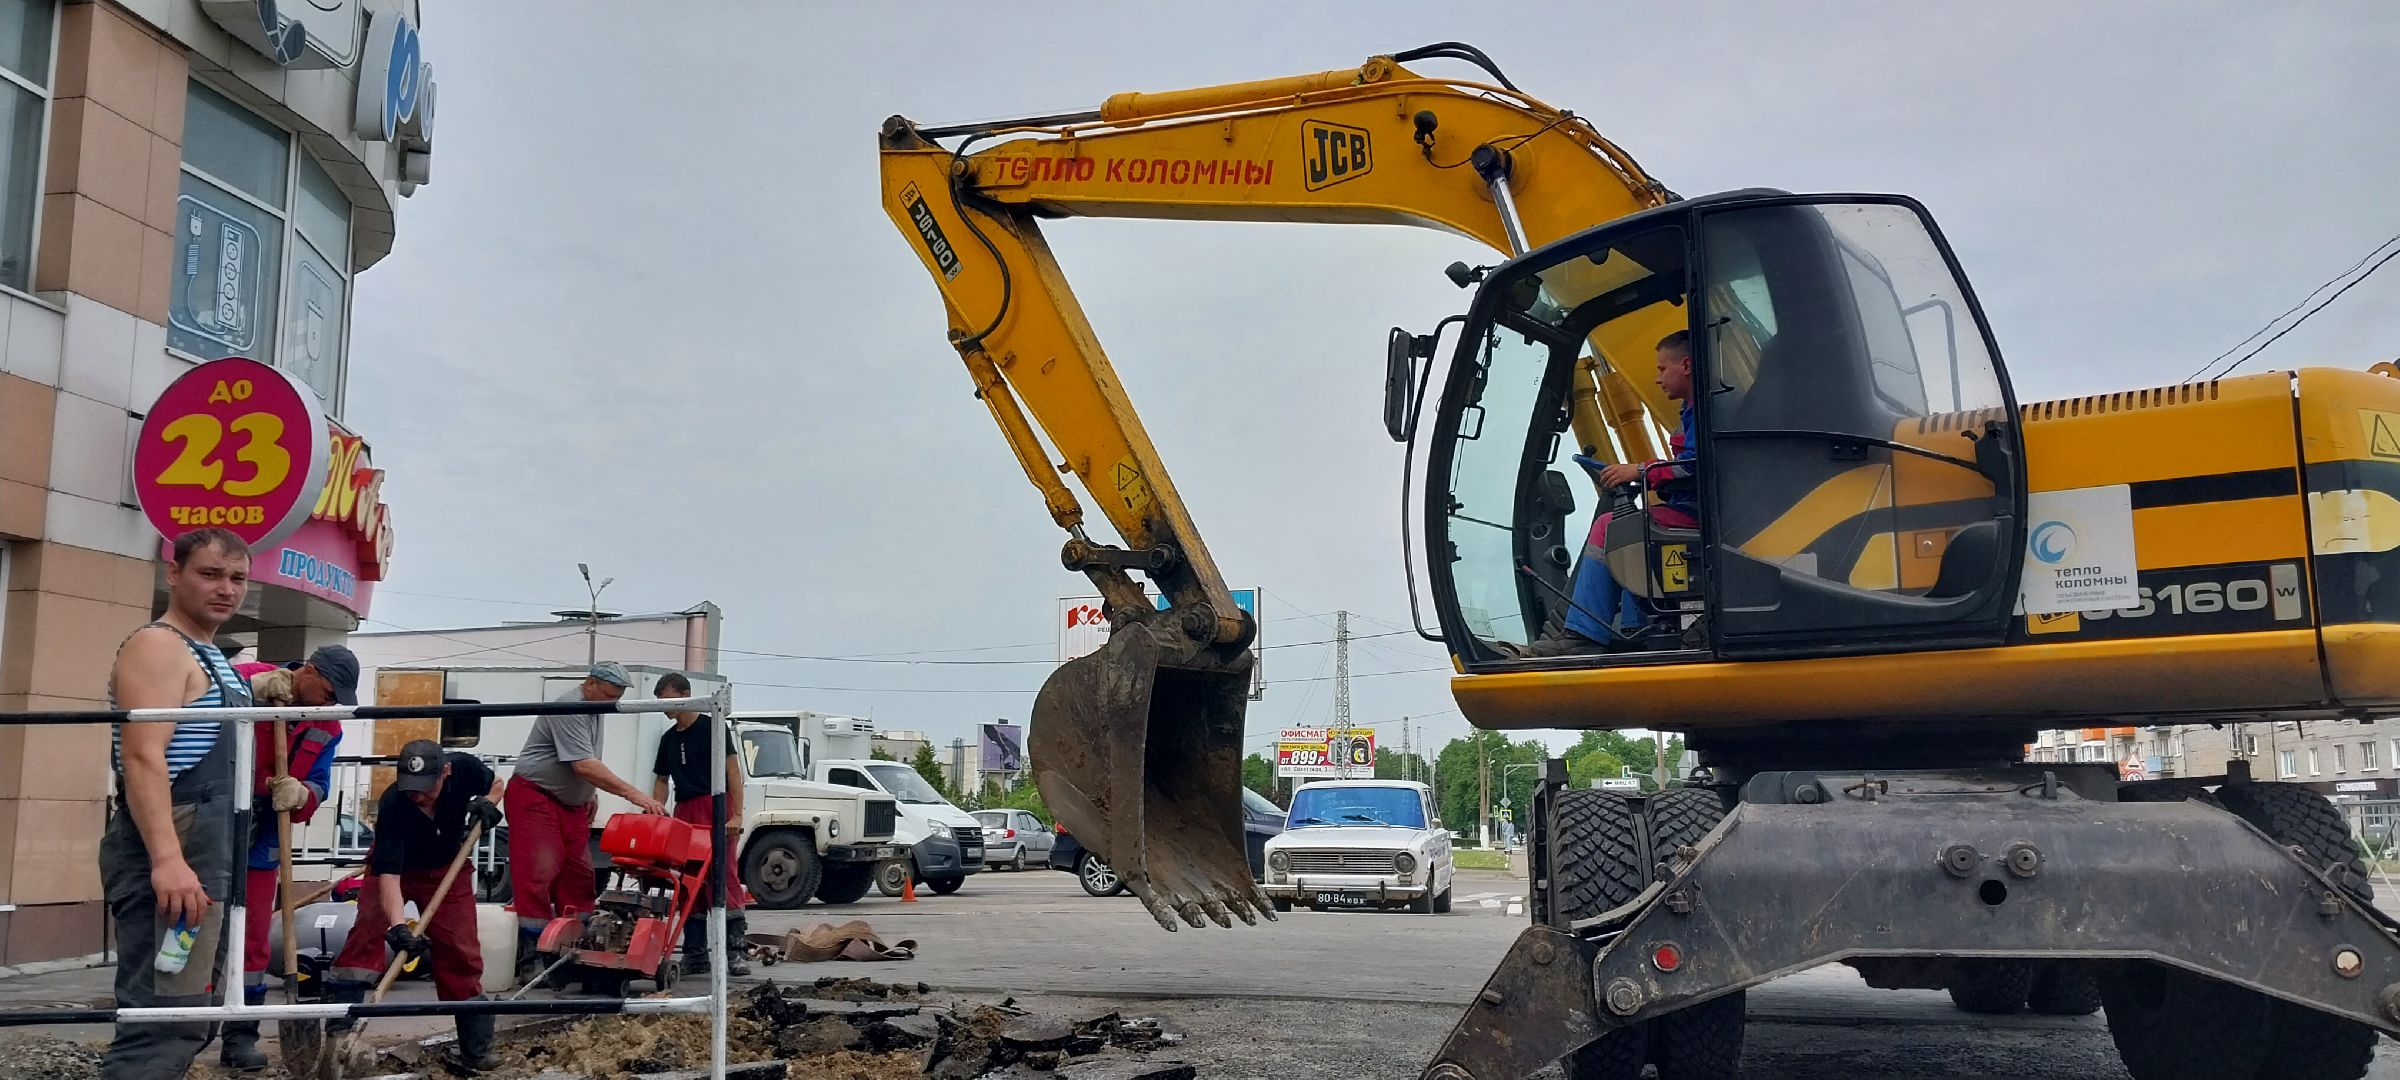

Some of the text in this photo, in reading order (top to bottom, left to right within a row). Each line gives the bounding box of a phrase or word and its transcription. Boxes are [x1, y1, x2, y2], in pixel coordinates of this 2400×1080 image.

[1310, 128, 1366, 183] JCB
[155, 412, 291, 496] 23
[2275, 586, 2297, 599] W
[1290, 750, 1318, 765] 899
